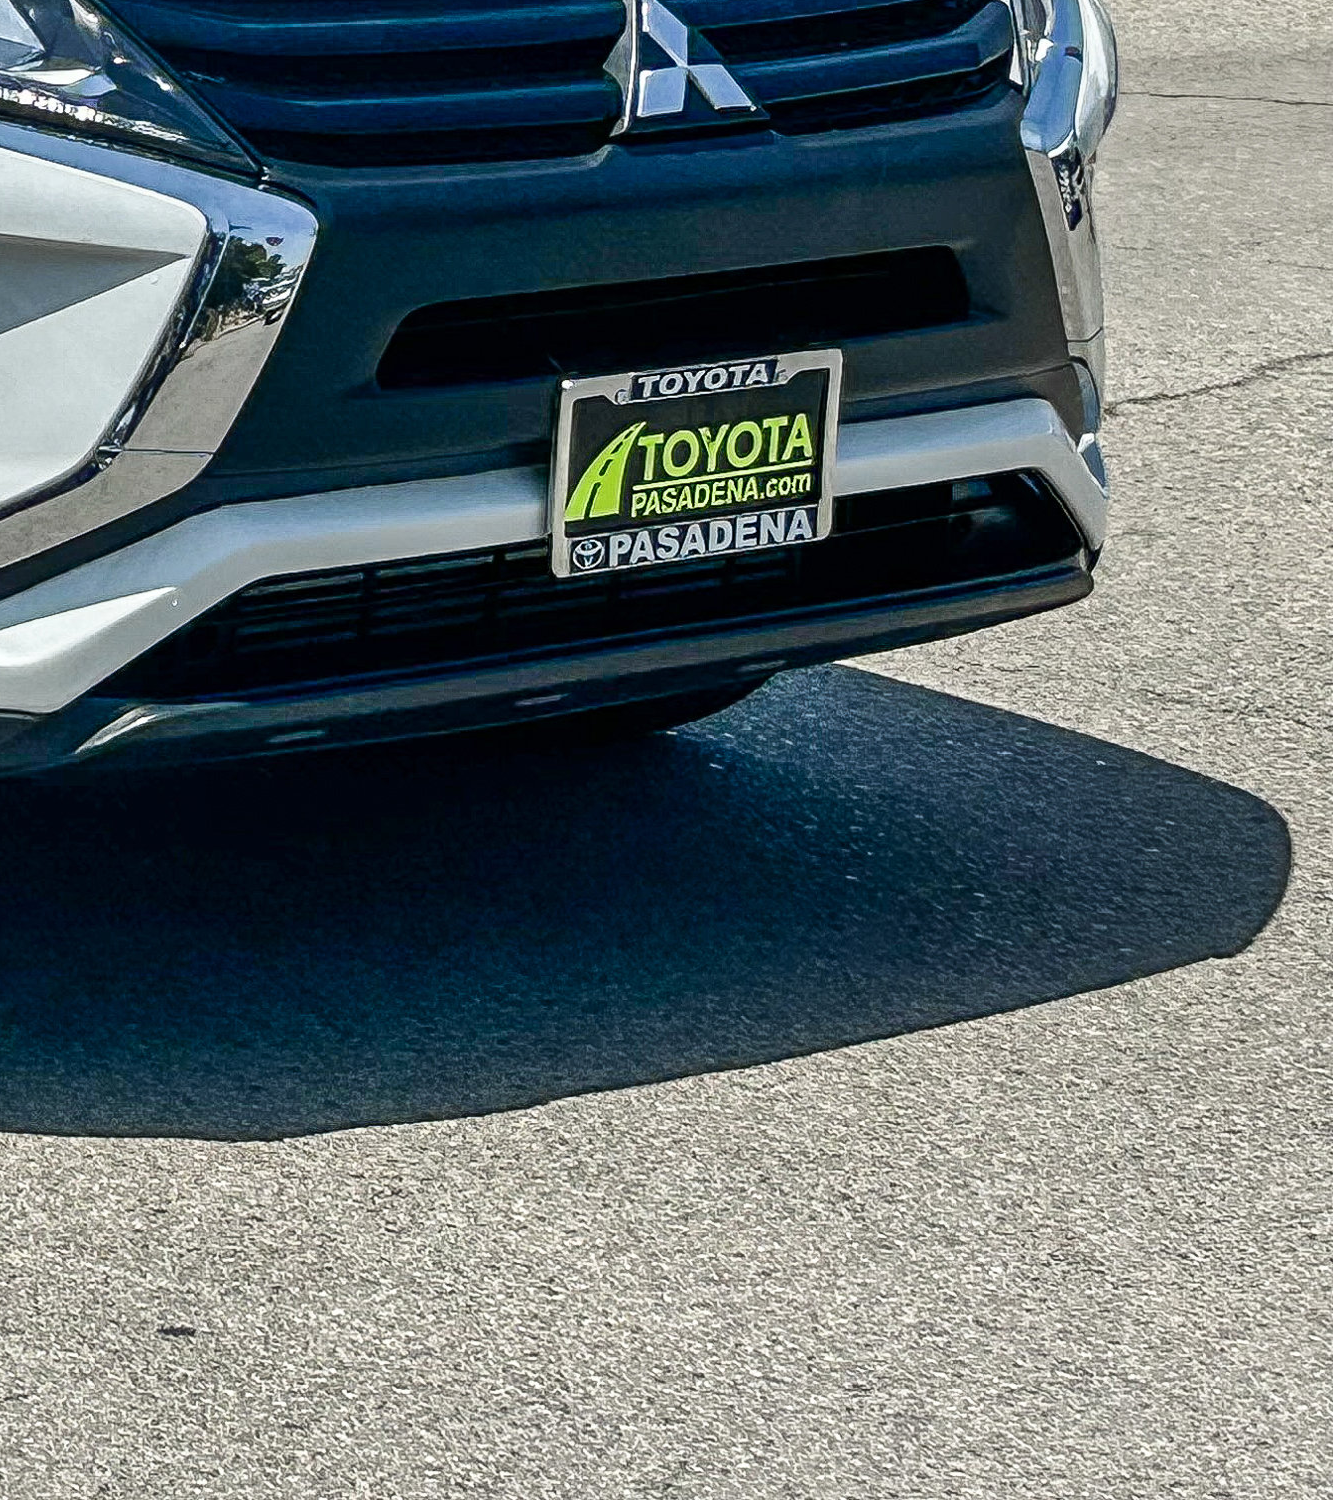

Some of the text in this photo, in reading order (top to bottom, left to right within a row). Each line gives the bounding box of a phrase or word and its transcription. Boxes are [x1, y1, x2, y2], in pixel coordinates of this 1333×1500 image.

[638, 364, 769, 397] TOYOTA
[637, 413, 813, 481] TOYOTA
[631, 473, 812, 518] PASADENA.com
[609, 510, 814, 567] PASADENA
